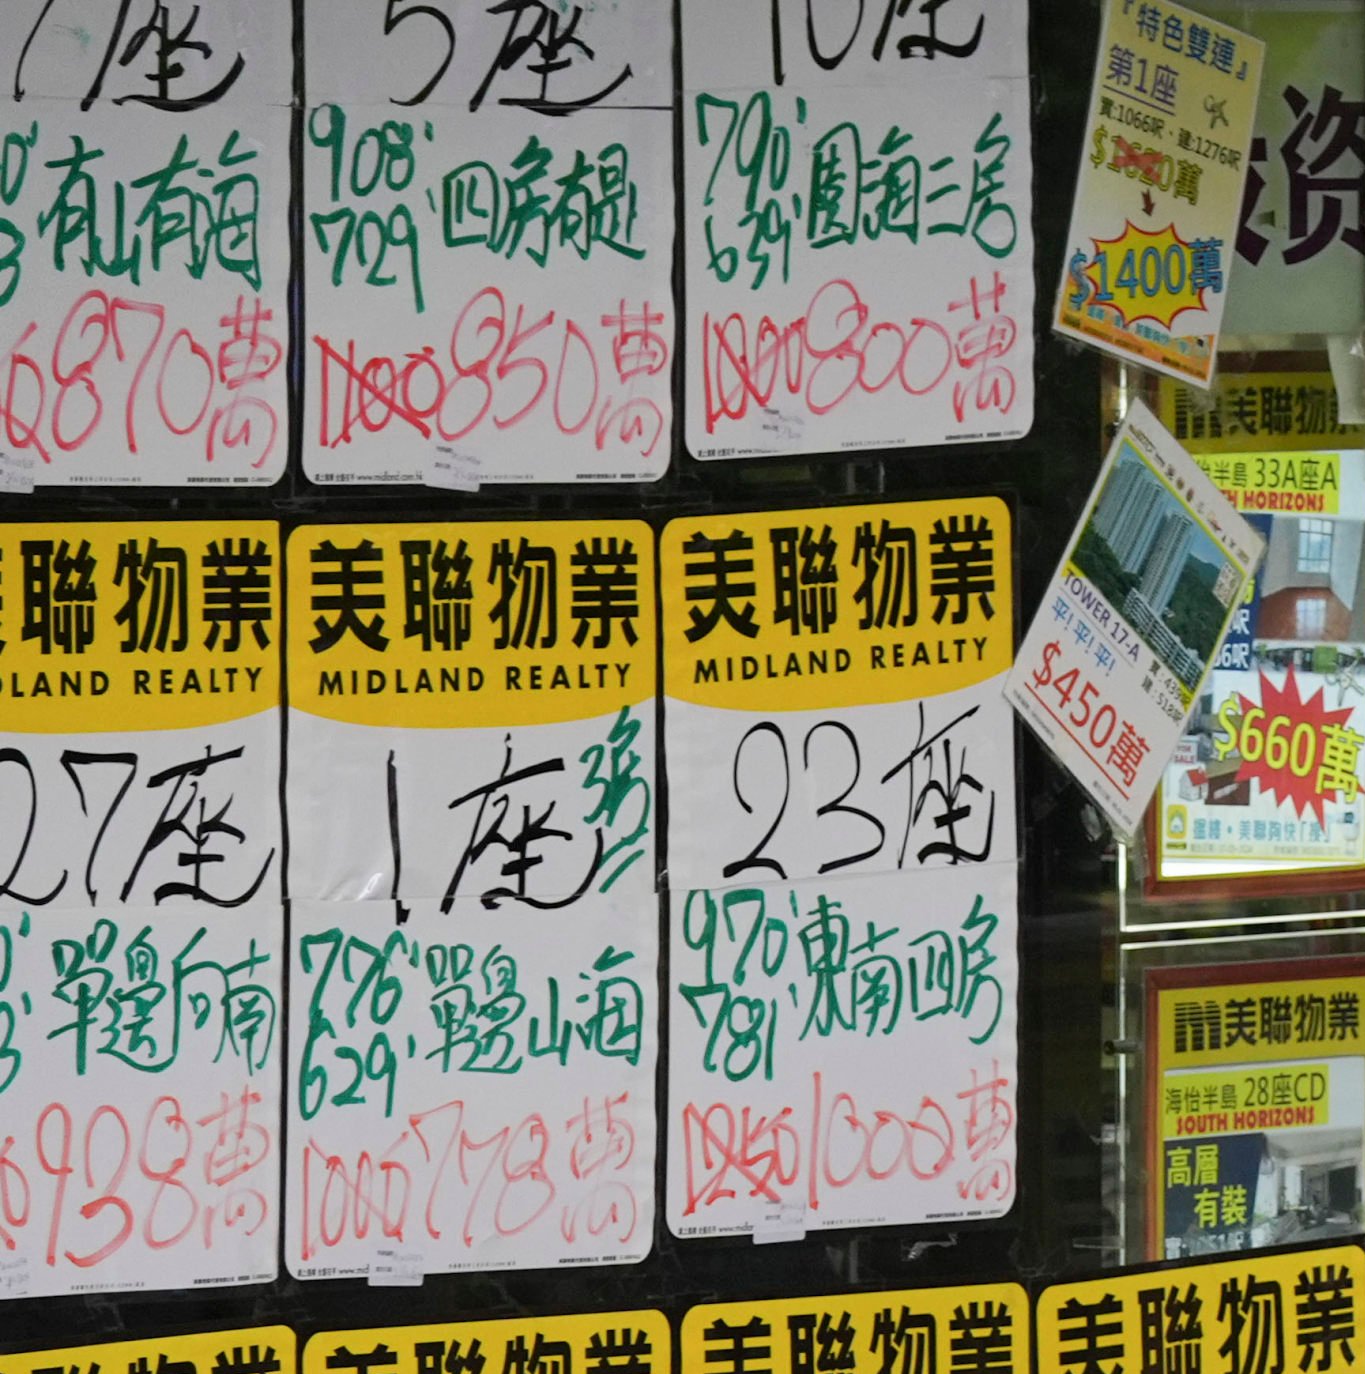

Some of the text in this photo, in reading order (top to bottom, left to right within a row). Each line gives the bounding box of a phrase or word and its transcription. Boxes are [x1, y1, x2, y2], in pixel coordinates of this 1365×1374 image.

[38, 130, 262, 292] 有山有海
[1069, 236, 1224, 310] $1400萬
[50, 290, 282, 468] 870萬
[436, 286, 668, 456] 850萬
[804, 272, 1018, 424] 800萬
[1243, 490, 1326, 512] HORIZONS
[1254, 456, 1338, 490] 33A座A
[0, 535, 273, 656] 聯物業
[308, 537, 640, 654] 美聯物業
[682, 520, 996, 644] 美聯物業
[1064, 568, 1112, 628] TOWER
[133, 667, 264, 695] REALTY
[318, 662, 632, 695] MIDLAND REALTY
[694, 637, 989, 684] MIDLAND REALTY
[1032, 638, 1152, 789] $450萬
[1213, 690, 1365, 803] $660萬
[722, 702, 996, 881] 23座
[1224, 992, 1360, 1048] 美聯物業
[1176, 1106, 1315, 1136] SOUTH HORIZONS
[1244, 1072, 1326, 1109] 28座CD
[1167, 1144, 1220, 1188] 高層
